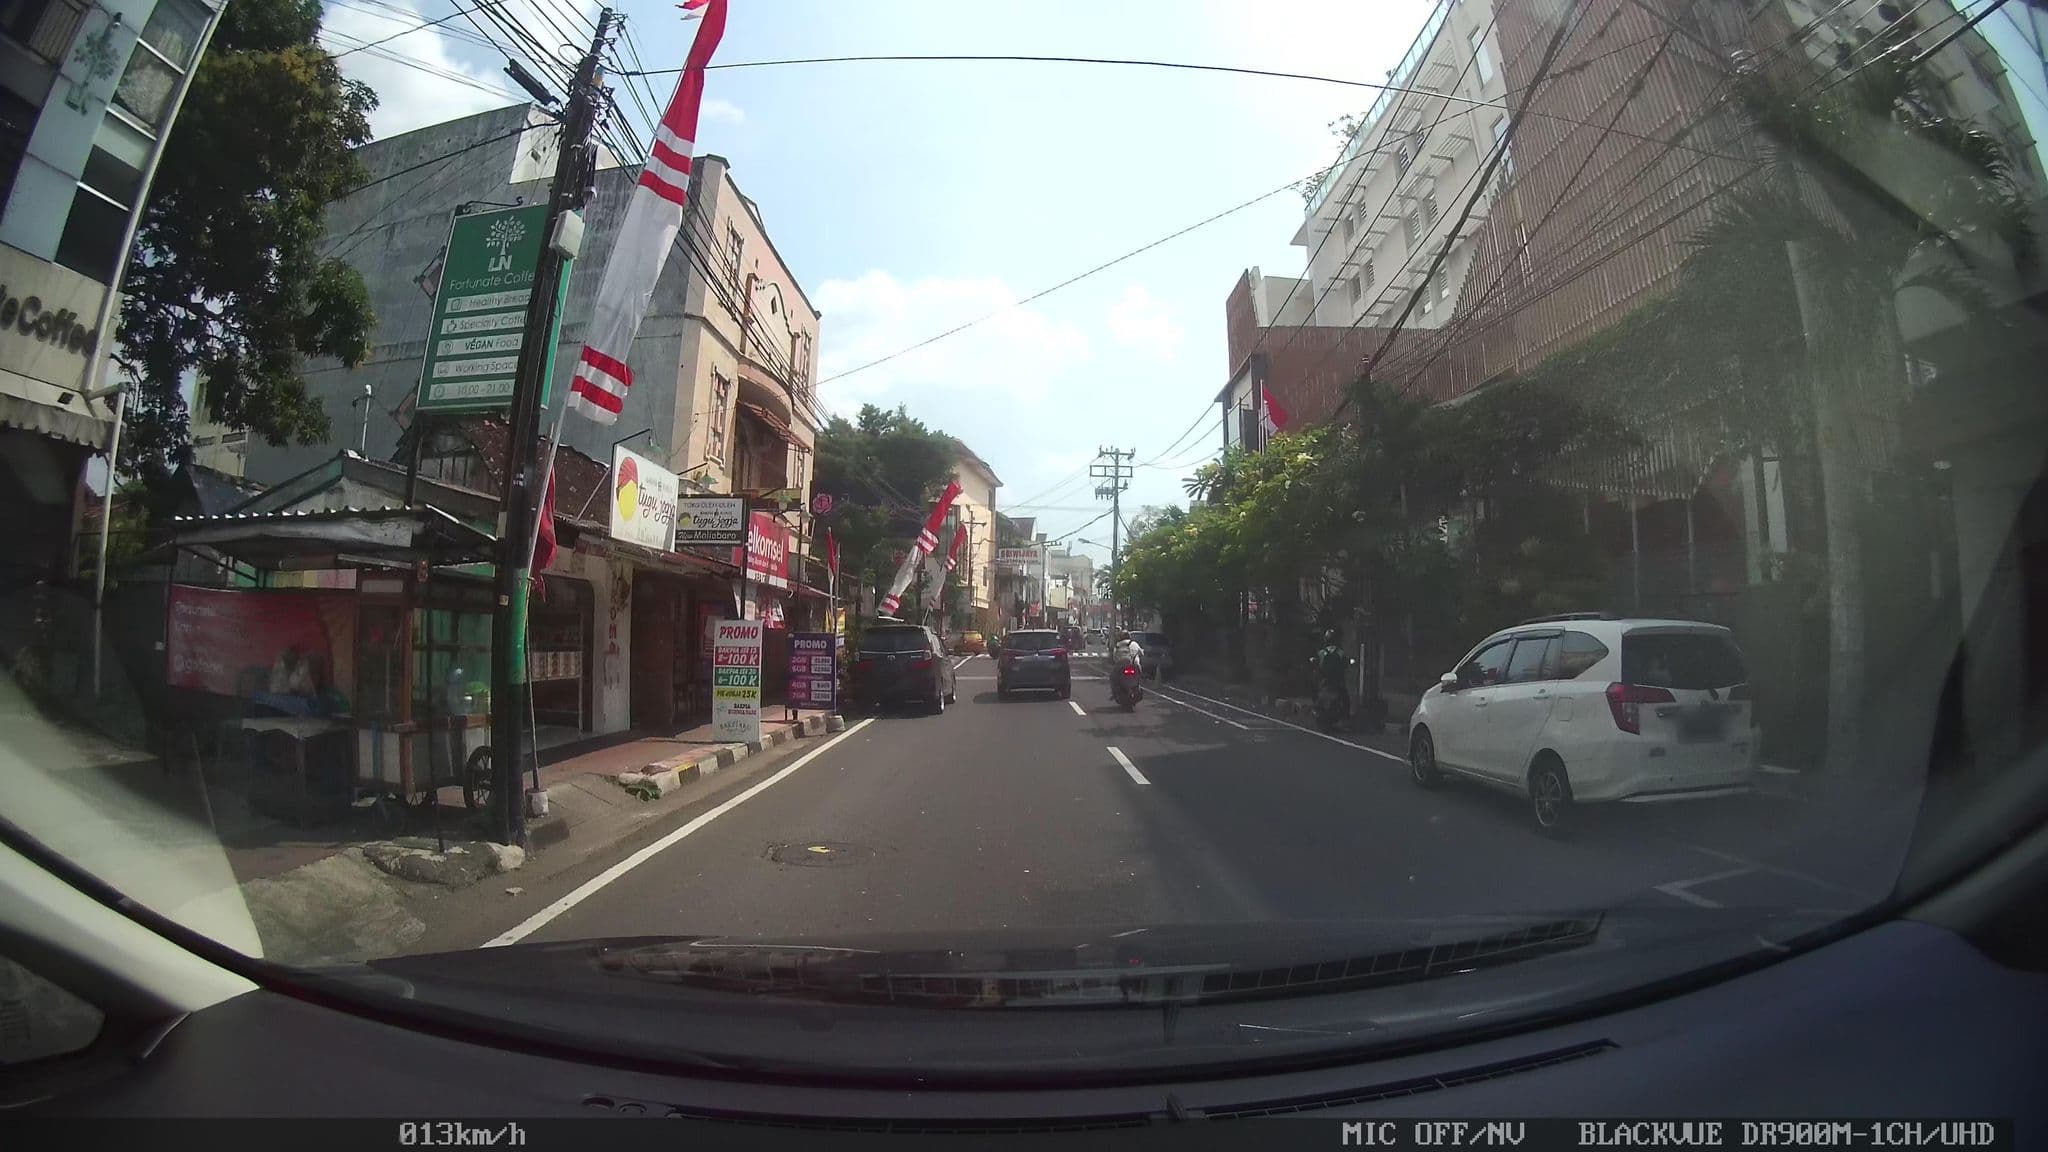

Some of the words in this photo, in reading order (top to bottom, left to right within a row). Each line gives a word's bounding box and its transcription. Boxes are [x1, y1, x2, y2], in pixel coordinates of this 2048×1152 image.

[488, 255, 512, 272] LN
[449, 276, 502, 291] Fortunate
[455, 362, 489, 375] Working
[719, 626, 759, 639] PROMO
[794, 640, 828, 649] PROMO
